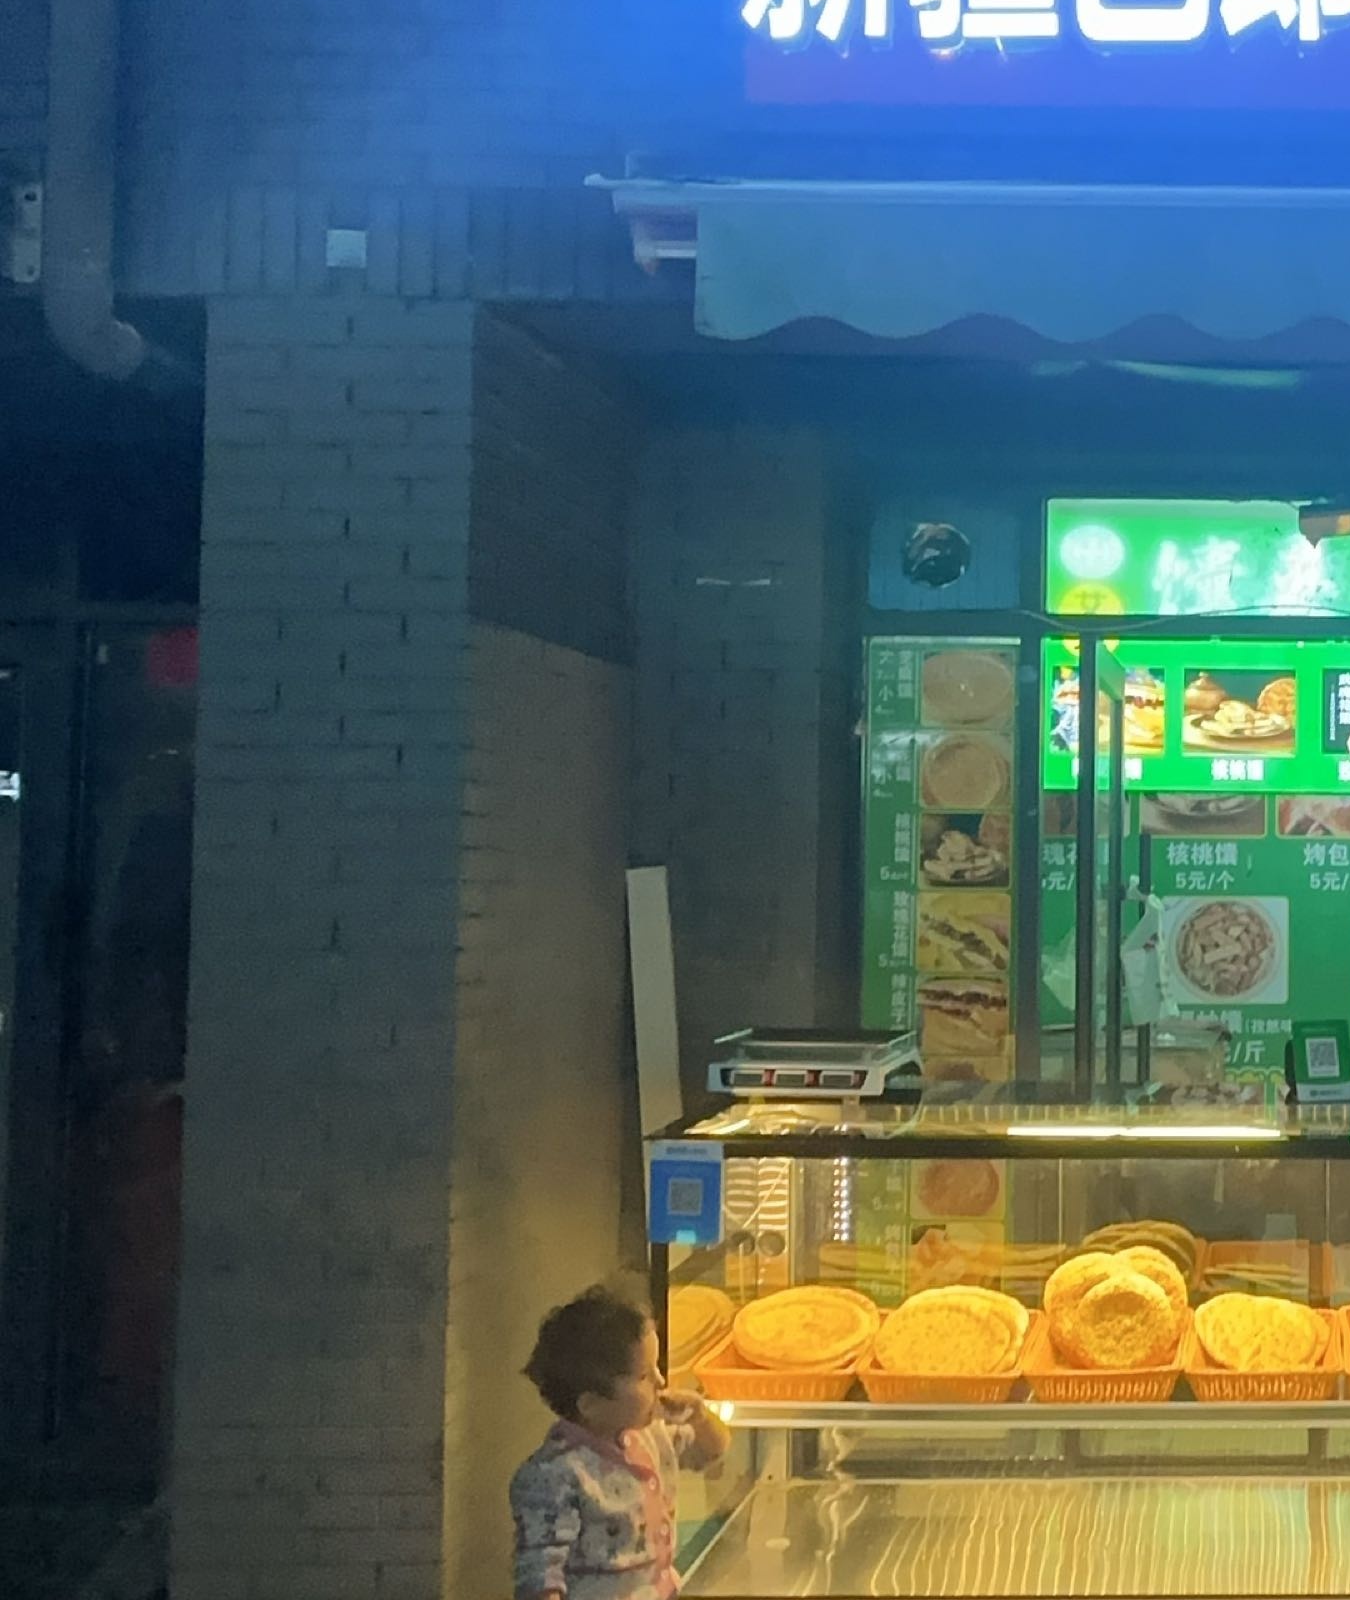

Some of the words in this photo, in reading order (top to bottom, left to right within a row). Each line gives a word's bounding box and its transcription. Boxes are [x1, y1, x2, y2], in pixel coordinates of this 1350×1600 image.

[1166, 841, 1238, 867] 核桃馕
[1175, 871, 1235, 891] 5元/个
